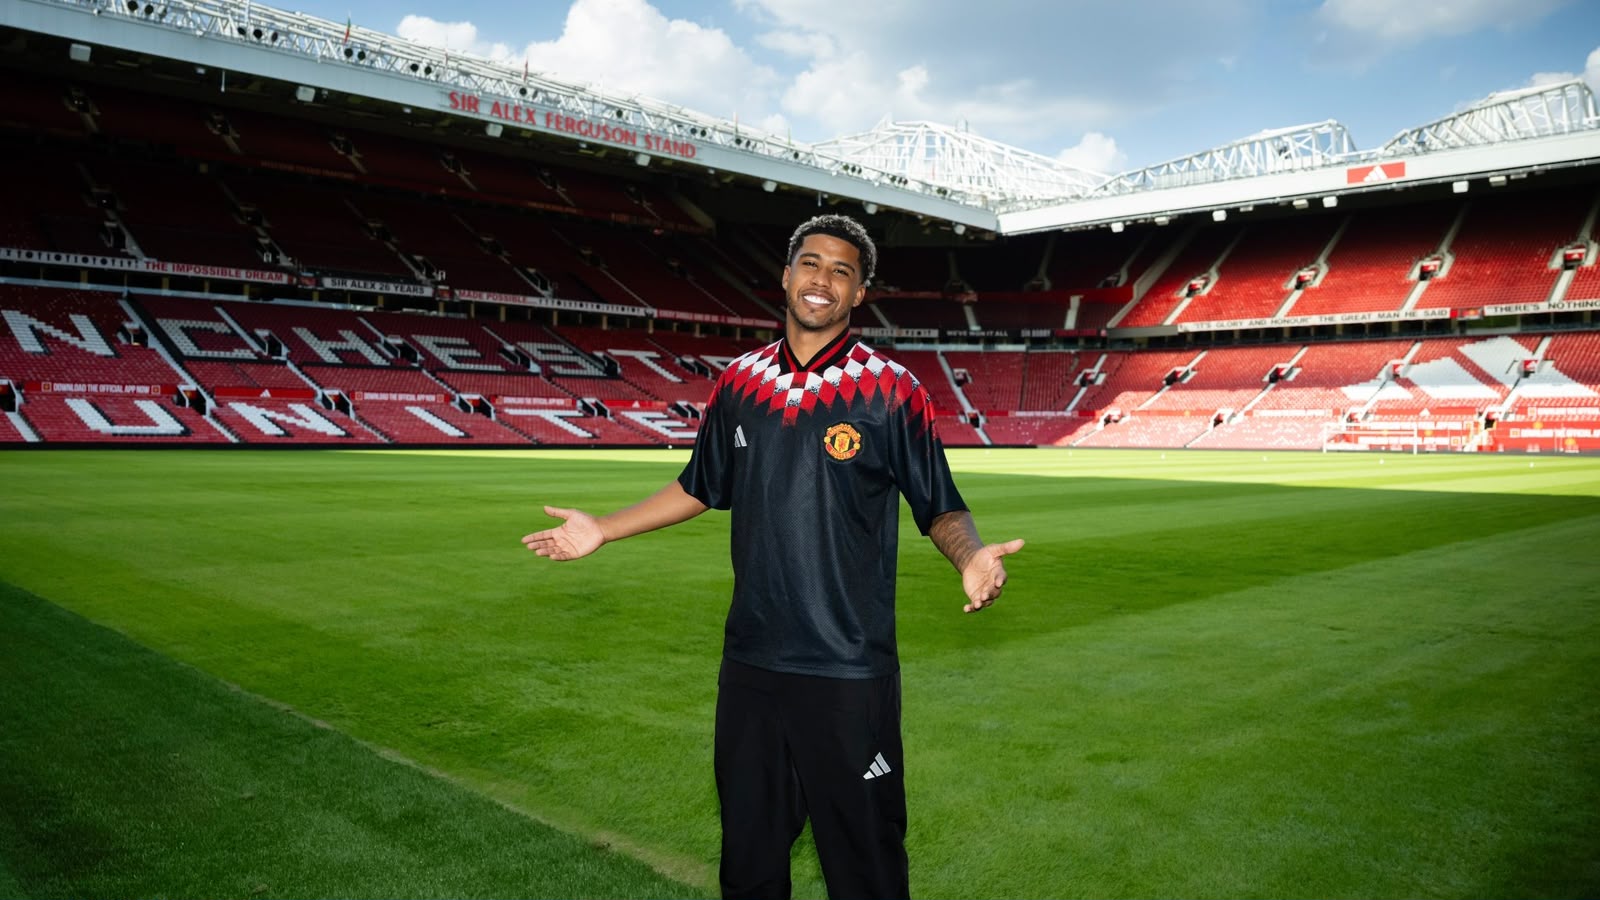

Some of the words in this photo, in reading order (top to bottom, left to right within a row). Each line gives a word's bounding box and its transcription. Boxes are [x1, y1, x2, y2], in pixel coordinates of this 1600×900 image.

[449, 91, 479, 114] SIR
[490, 101, 537, 126] ALEX
[546, 112, 637, 147] FERGUSON
[645, 134, 696, 159] STAND
[144, 260, 168, 272] THE
[172, 264, 241, 278] IMPOSSIBLE
[245, 271, 283, 282] DREAM
[331, 278, 347, 287] SIR
[351, 281, 376, 290] ALEX
[379, 282, 390, 291] 26
[395, 284, 424, 294] YEARS
[459, 289, 483, 300] MADE
[1319, 315, 1334, 323] THE
[1341, 313, 1372, 322] GREAT
[1377, 312, 1400, 320] MAN
[1405, 310, 1417, 318] HE
[1424, 309, 1448, 317] SAID
[53, 383, 87, 392] DOWNLOAD
[88, 383, 98, 392] THE
[99, 384, 123, 393] OFFICIAL
[125, 385, 136, 393] APP
